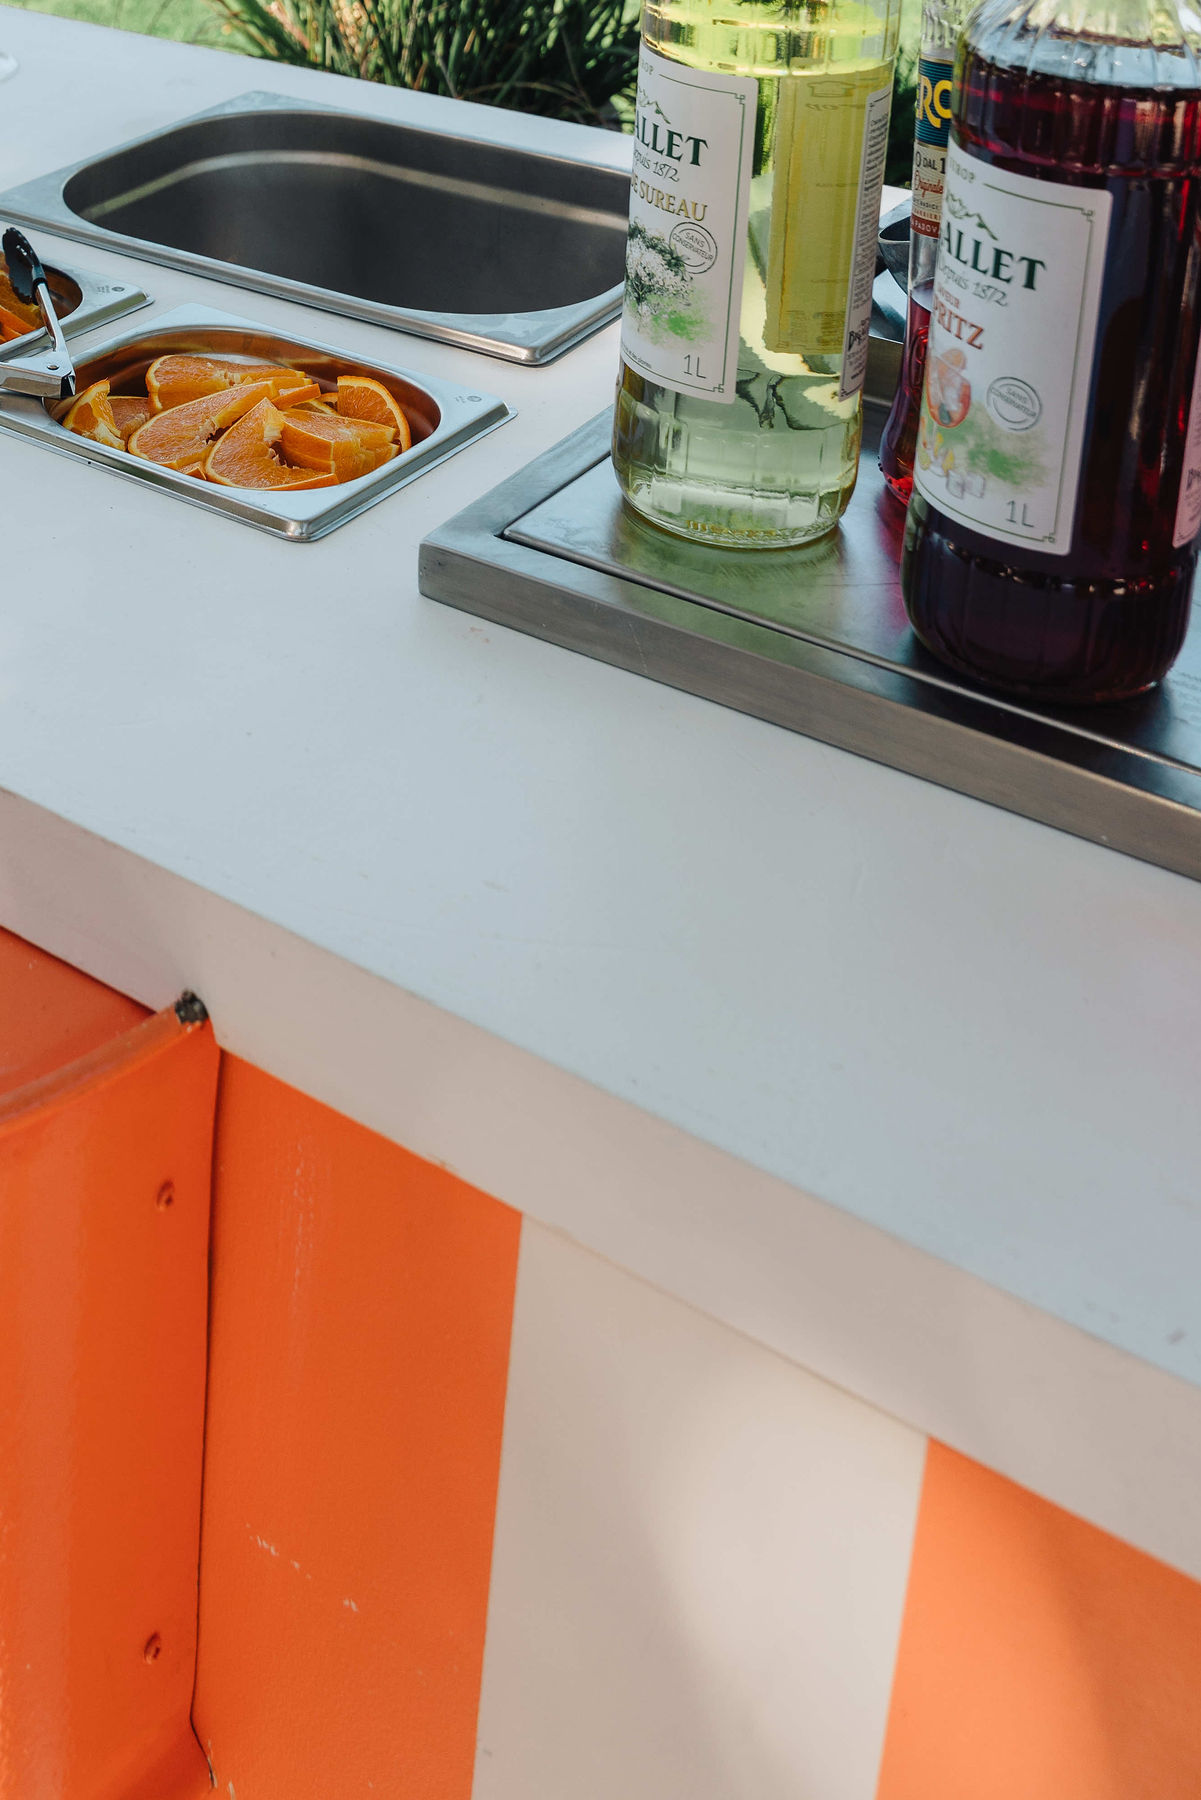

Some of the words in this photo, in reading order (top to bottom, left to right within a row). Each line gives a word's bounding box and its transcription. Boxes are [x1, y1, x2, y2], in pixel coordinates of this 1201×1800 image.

[653, 161, 680, 183] 1872
[922, 157, 938, 171] DAL
[639, 179, 708, 222] SUREAU
[684, 231, 706, 248] SANS
